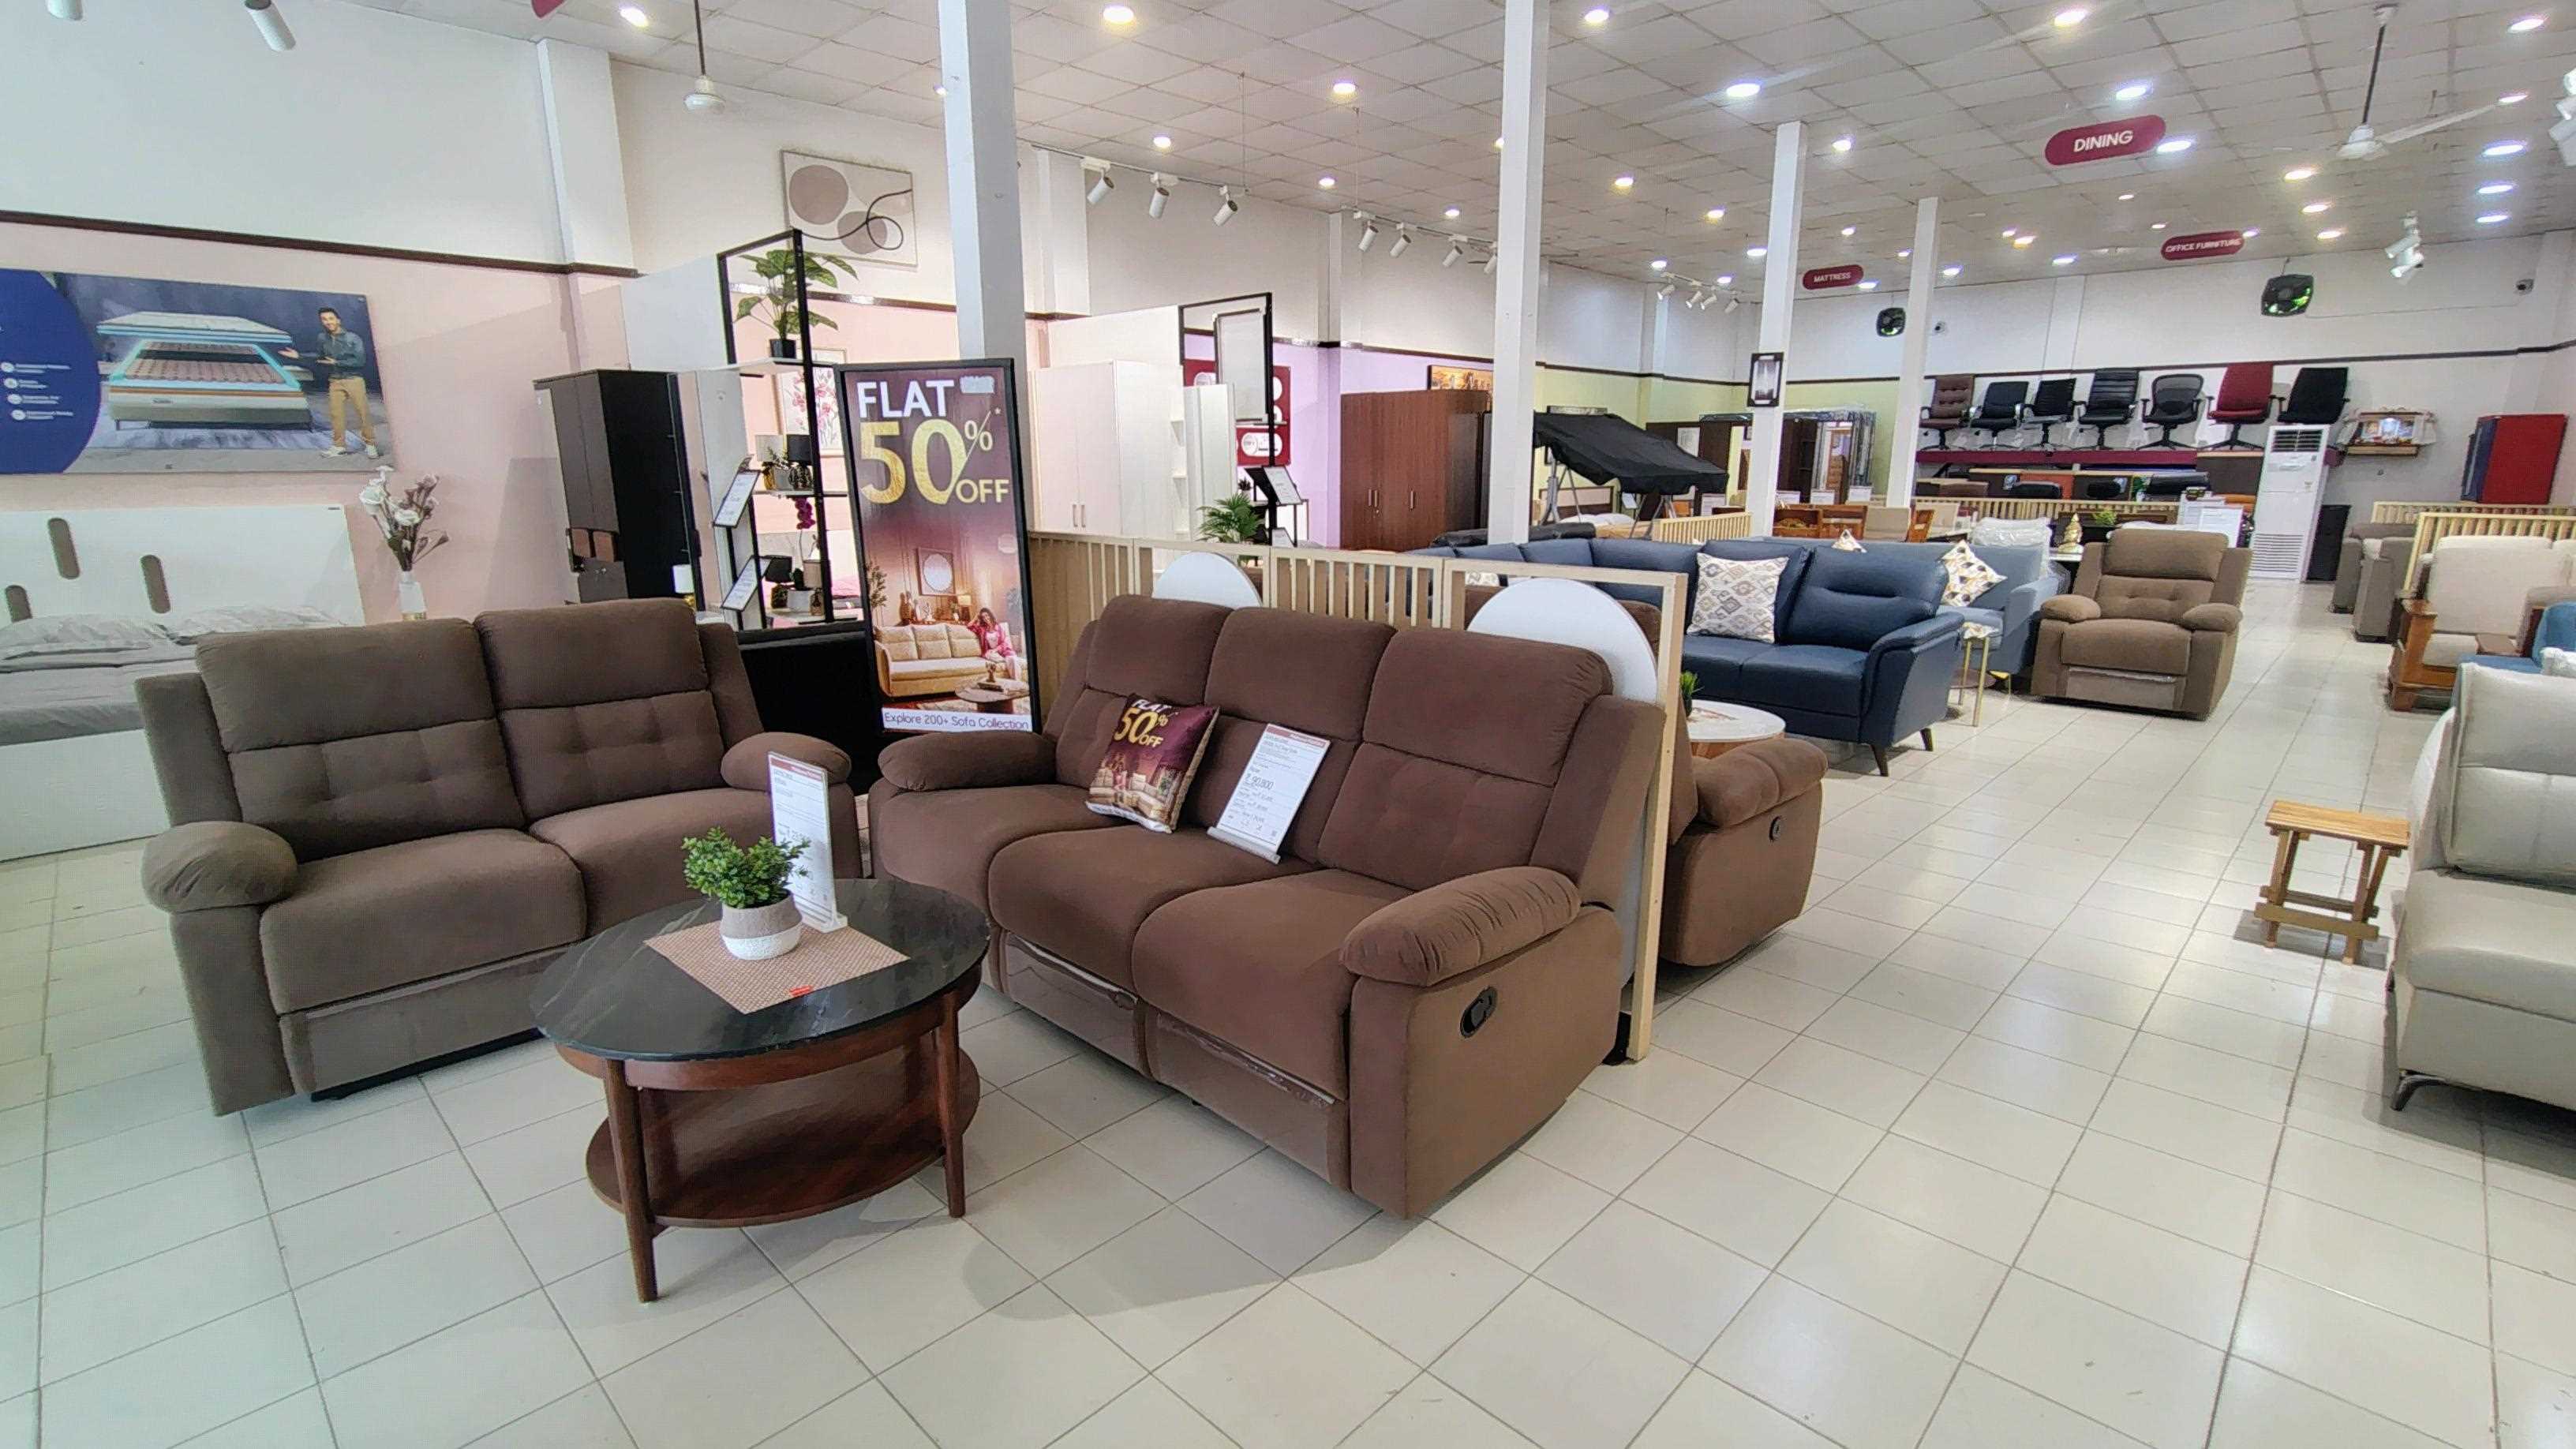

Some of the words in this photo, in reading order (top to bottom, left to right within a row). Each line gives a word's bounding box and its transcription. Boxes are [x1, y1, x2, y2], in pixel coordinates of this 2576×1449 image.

[2073, 130, 2134, 152] DINING
[2165, 243, 2195, 253] OFFICE
[1814, 272, 1852, 283] MATTRESS
[857, 380, 955, 418] FLAT
[955, 478, 1009, 504] OFF
[884, 713, 922, 724] Explore
[924, 714, 948, 725] 200+
[951, 717, 976, 728] Sofa
[979, 717, 1029, 729] Collection
[1138, 734, 1164, 747] OFF
